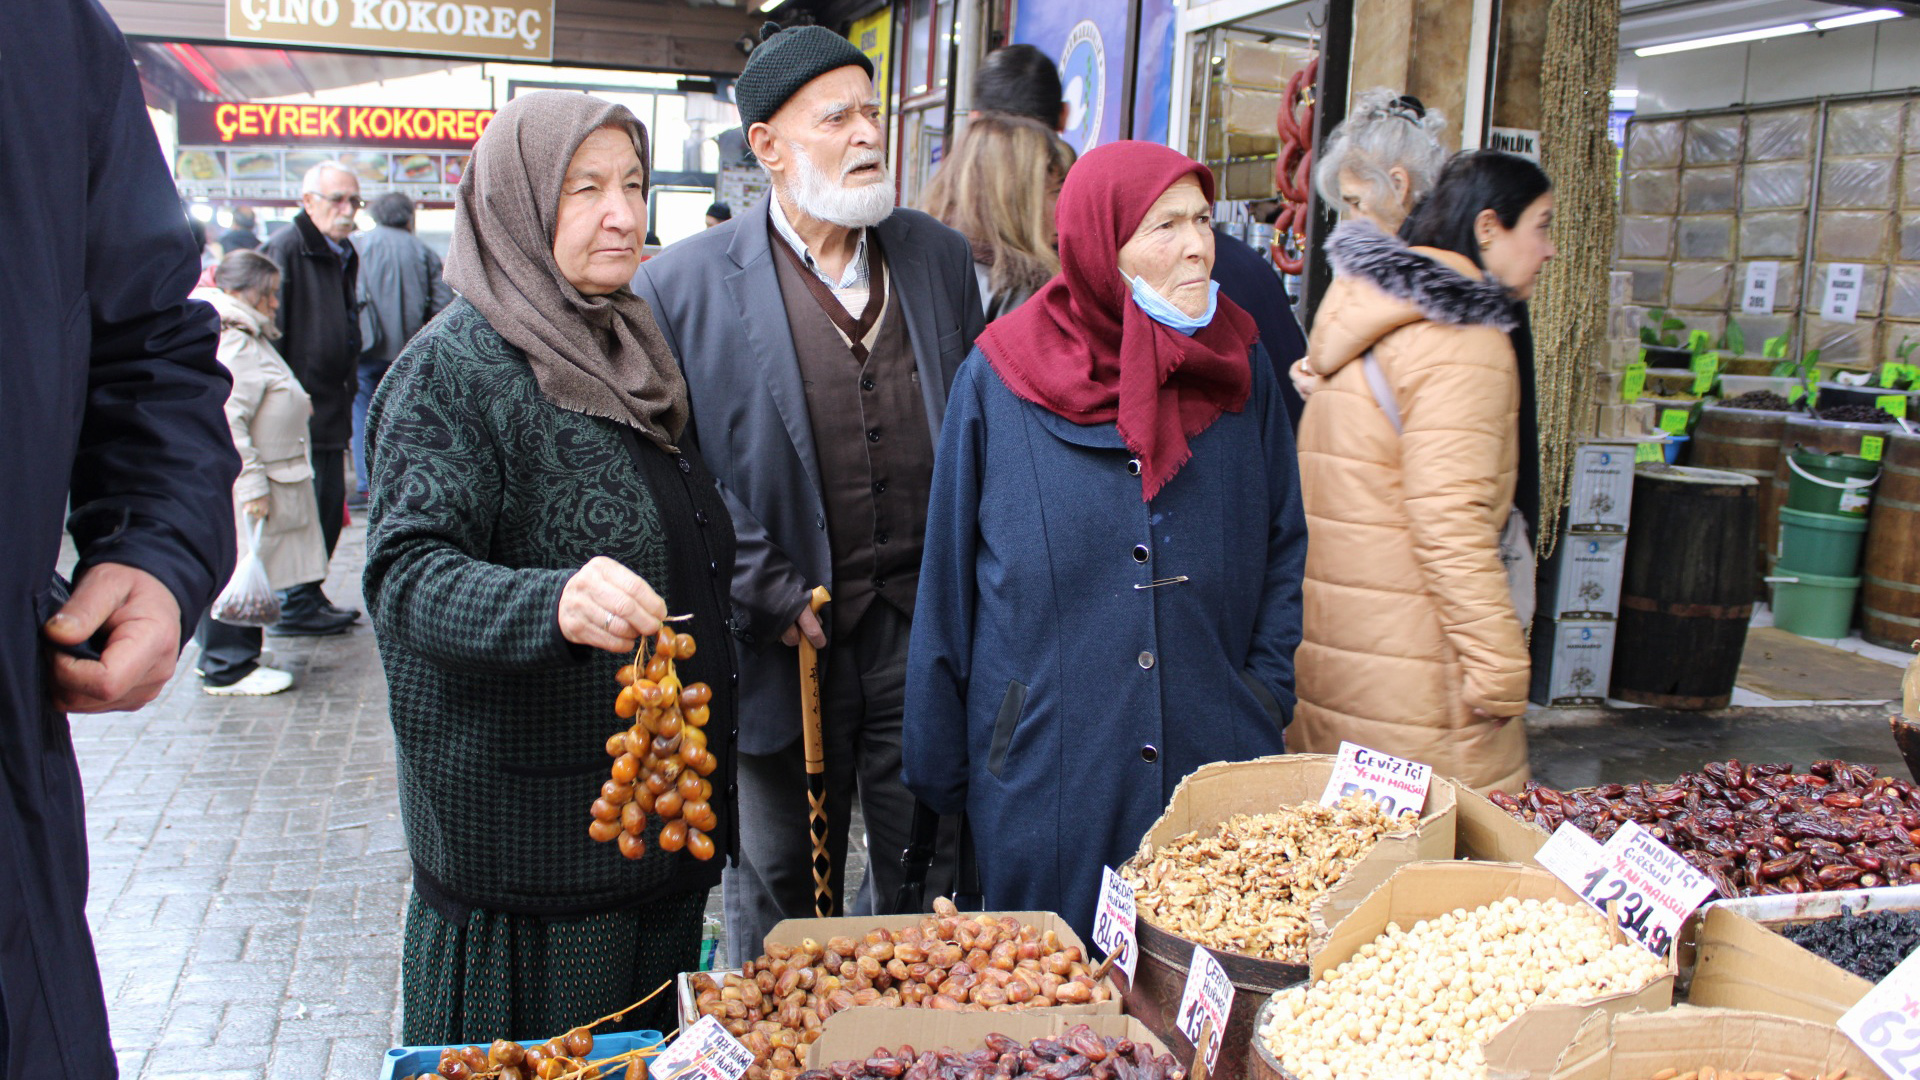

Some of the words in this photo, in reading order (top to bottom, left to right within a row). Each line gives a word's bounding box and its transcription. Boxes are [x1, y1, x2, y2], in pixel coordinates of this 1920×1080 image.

[350, 1, 542, 50] KOKOREÇ
[215, 103, 342, 141] ÇEYREK
[1630, 830, 1680, 873] FINDIK
